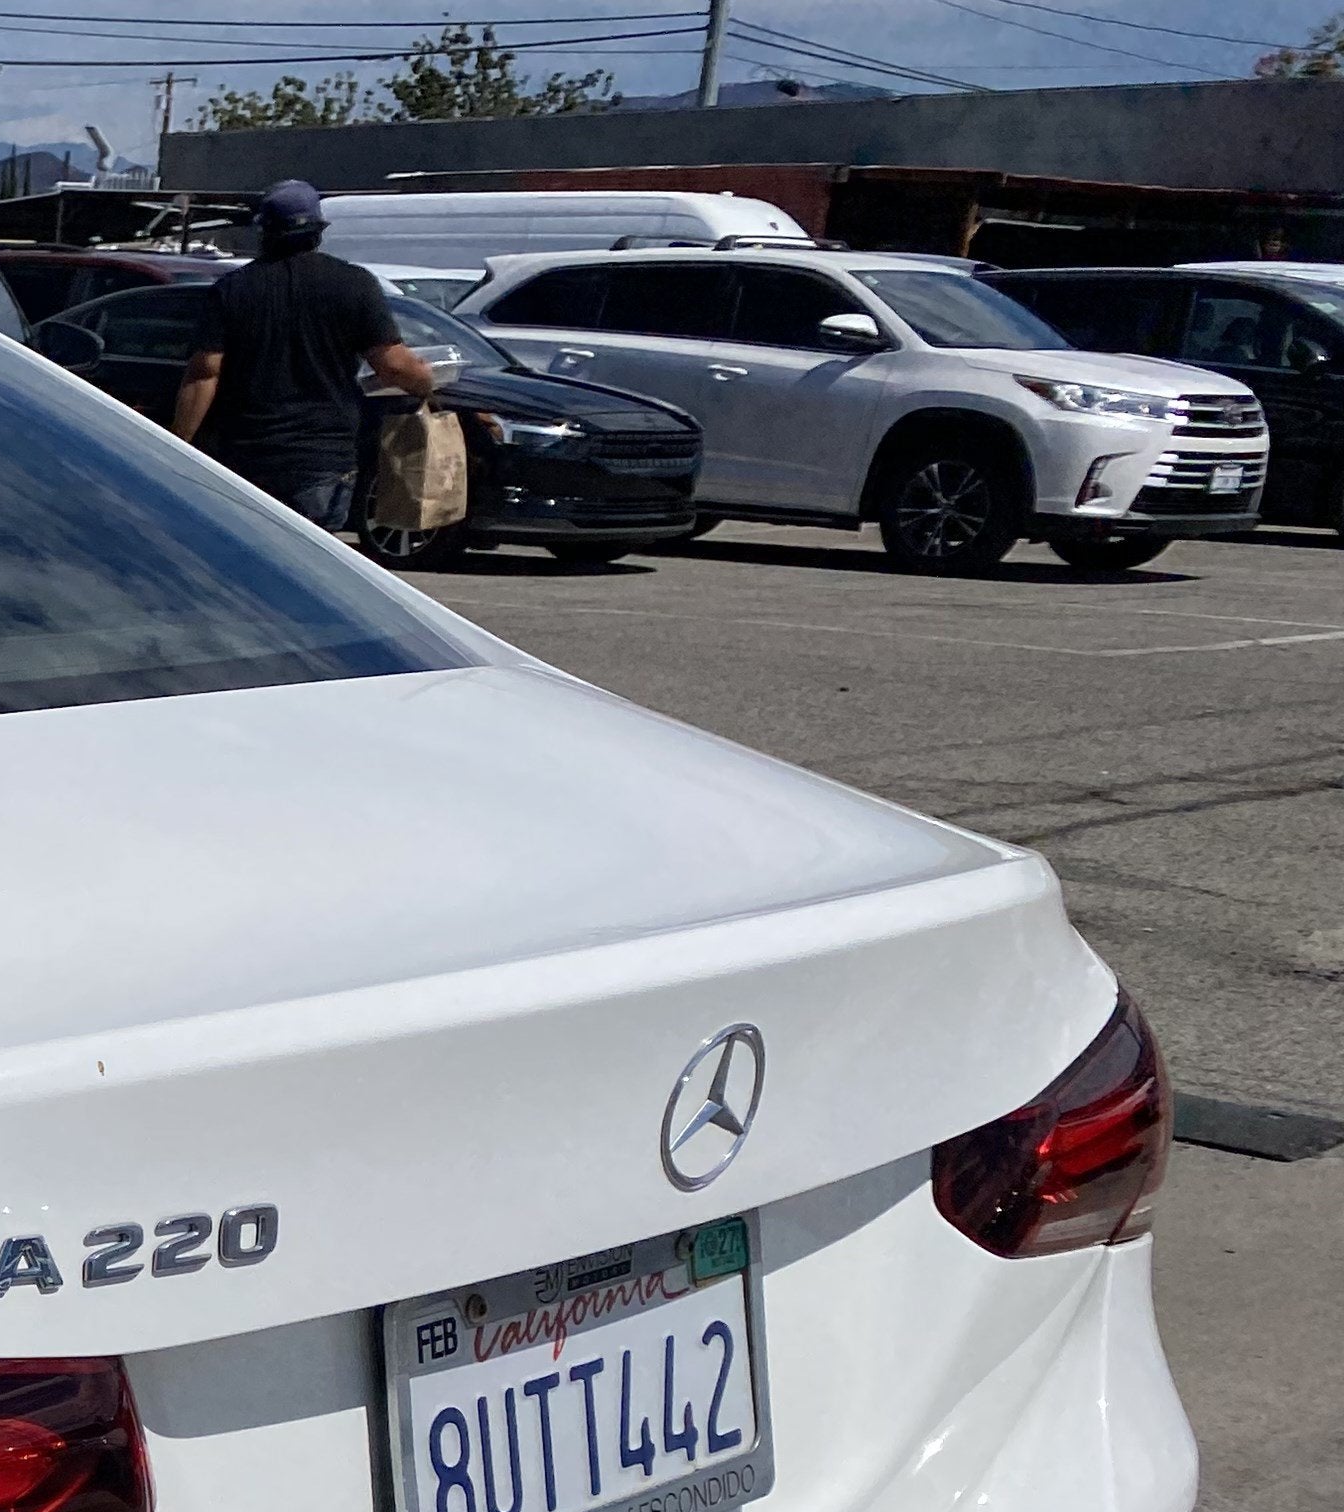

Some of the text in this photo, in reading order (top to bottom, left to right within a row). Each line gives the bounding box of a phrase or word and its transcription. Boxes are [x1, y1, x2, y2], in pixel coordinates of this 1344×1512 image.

[81, 1202, 279, 1289] 220
[416, 1315, 459, 1364] FEB
[473, 1271, 690, 1363] California
